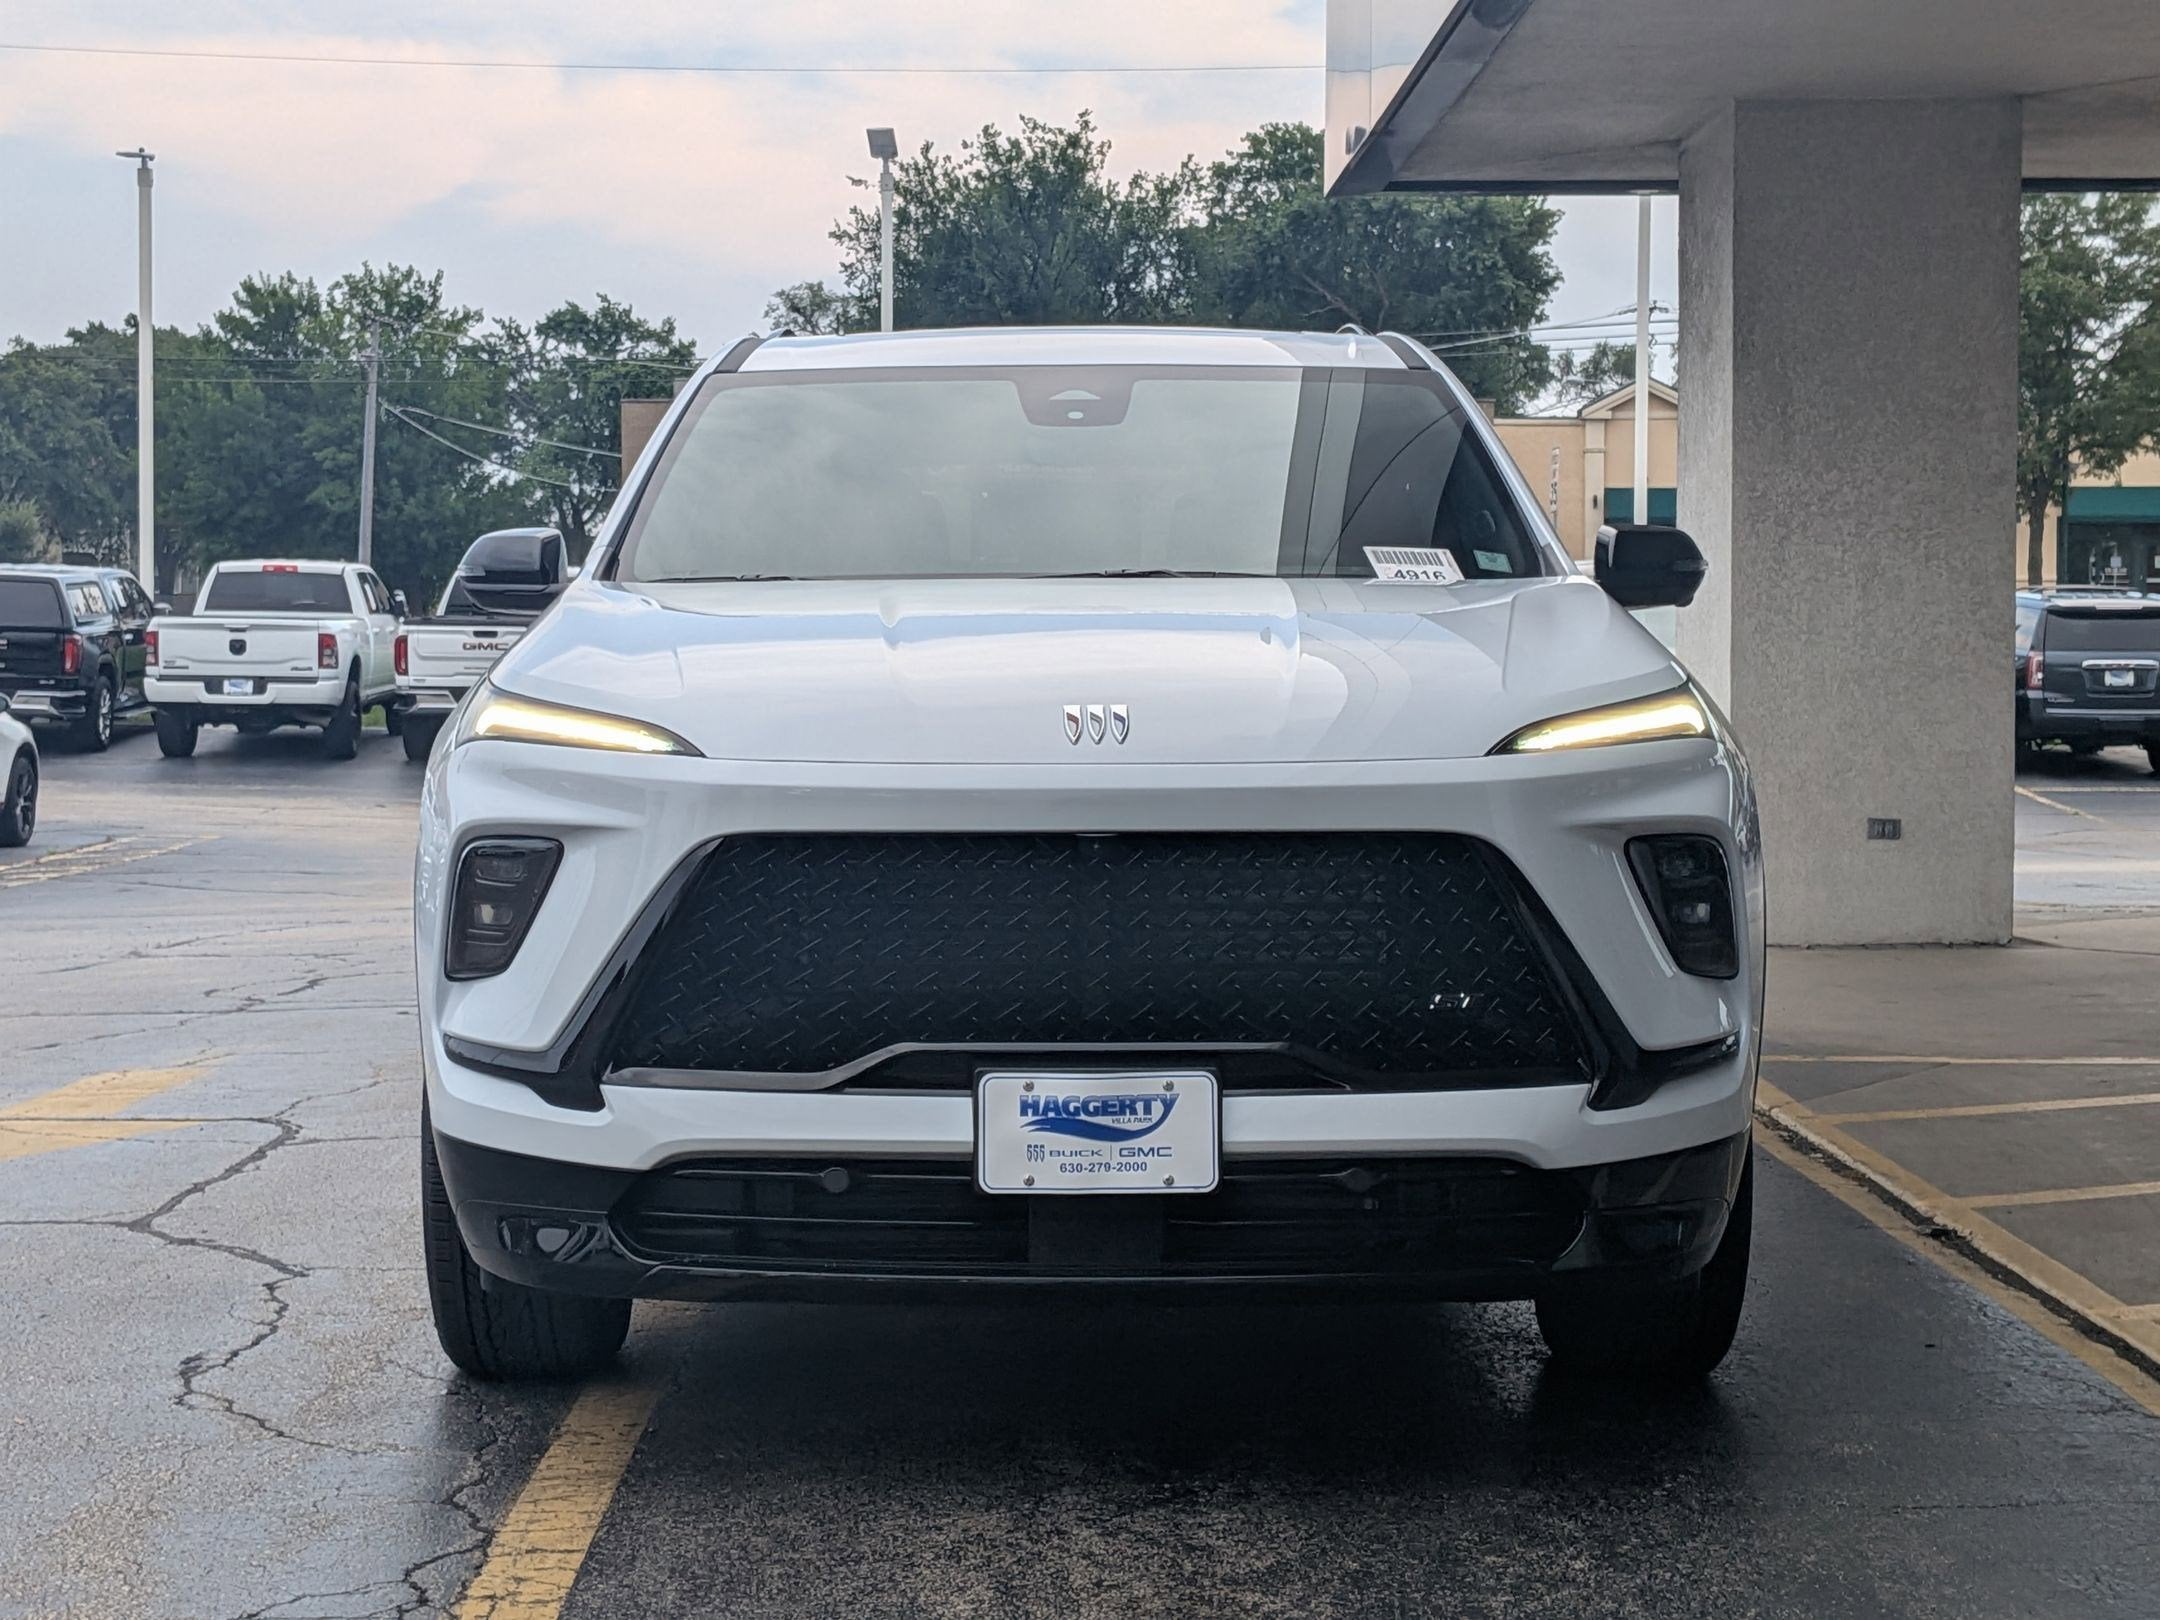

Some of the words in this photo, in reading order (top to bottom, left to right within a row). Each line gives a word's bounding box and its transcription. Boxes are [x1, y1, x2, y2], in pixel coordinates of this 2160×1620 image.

[462, 642, 509, 651] GMC
[1019, 1093, 1180, 1118] HAGGERTY
[1111, 1117, 1132, 1125] VILLA
[1133, 1116, 1154, 1124] PARK
[1049, 1149, 1104, 1158] BUICK
[1118, 1146, 1173, 1158] GMC
[1059, 1161, 1148, 1174] 630-279-2000
